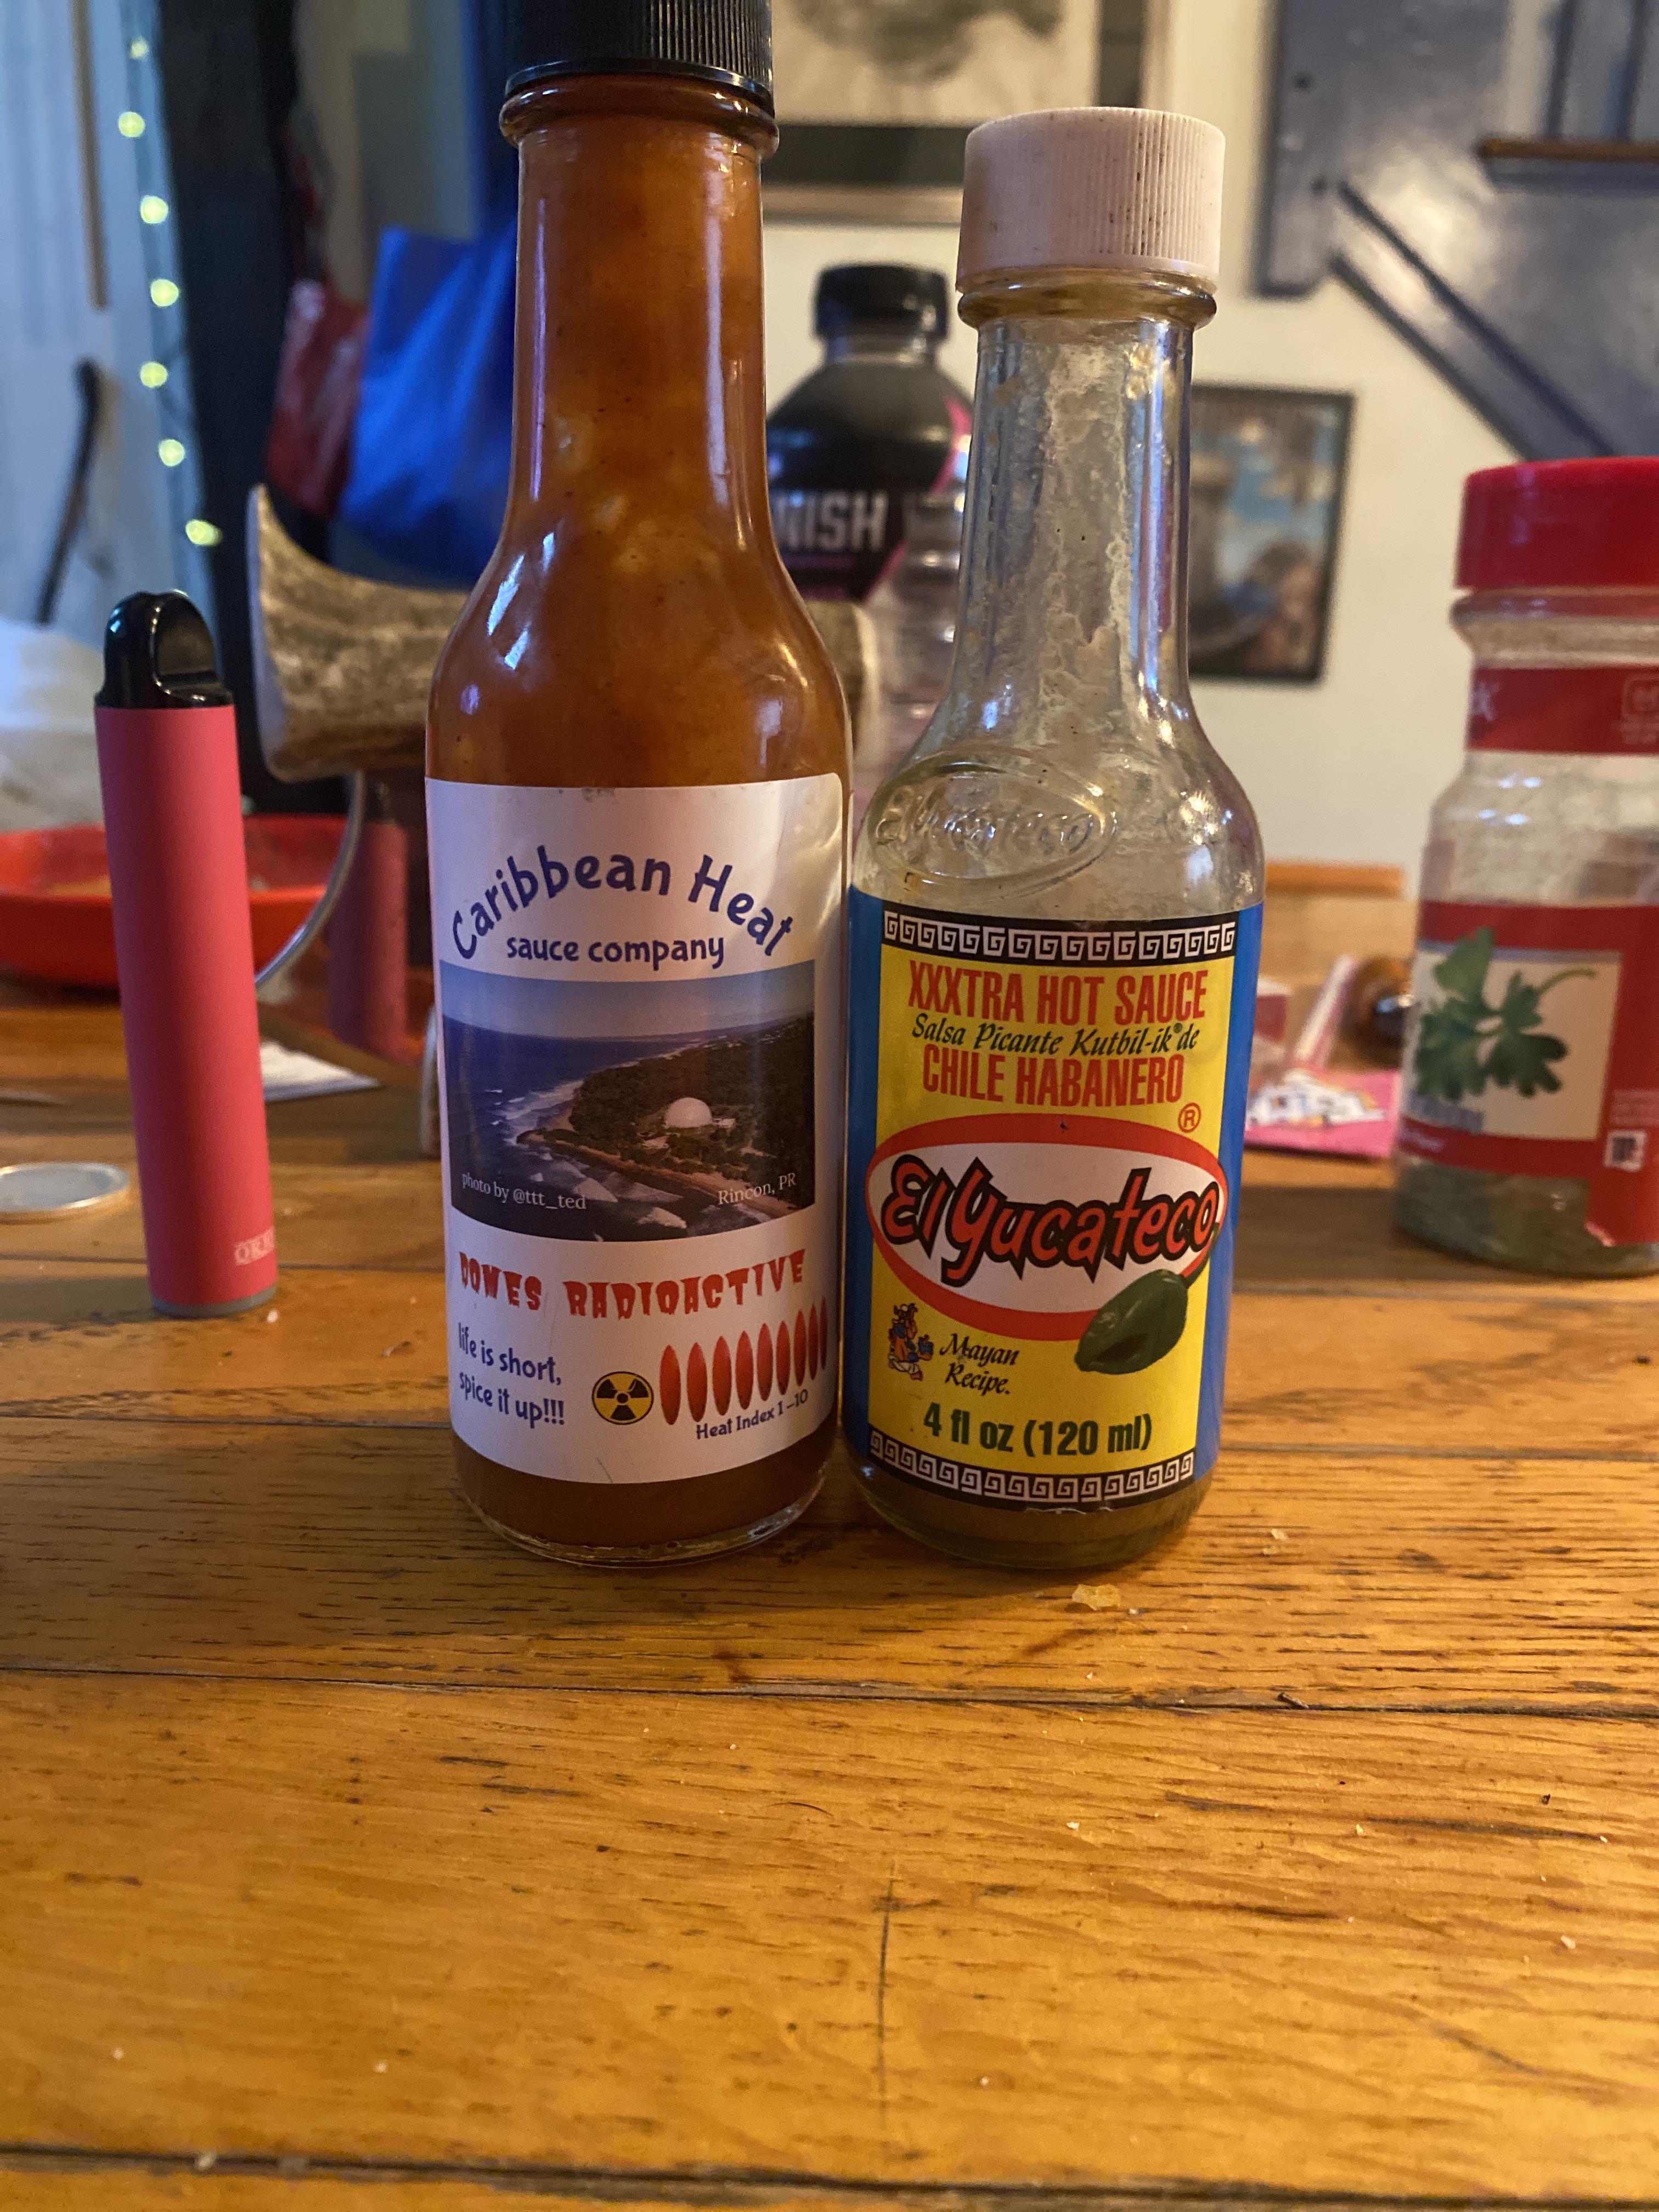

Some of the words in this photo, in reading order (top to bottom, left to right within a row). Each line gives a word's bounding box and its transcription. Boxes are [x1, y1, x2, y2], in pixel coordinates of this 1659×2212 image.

[453, 845, 670, 959] Caribbean
[688, 855, 793, 956] Heat
[507, 936, 578, 962] sauce
[589, 936, 725, 970] company
[909, 960, 1024, 1024] XXXTRA
[1037, 974, 1104, 1026] HOT
[1114, 970, 1209, 1025] SAUCE
[912, 1013, 966, 1046] Salsa
[976, 1023, 1063, 1055] Picante
[1177, 1023, 1200, 1051] de
[922, 1043, 1005, 1102] CHILE
[1015, 1053, 1184, 1107] HABANERO
[462, 1172, 490, 1194] photo
[494, 1181, 509, 1203] by
[514, 1188, 586, 1209] @ttt_ted
[718, 1181, 775, 1205] Rincon,
[778, 1172, 796, 1189] PR
[881, 1154, 956, 1258] El
[941, 1157, 1220, 1287] Yucateco
[562, 1249, 805, 1319] RADIOACTIVE
[459, 1323, 477, 1358] life
[481, 1340, 494, 1366] is
[500, 1347, 561, 1386] short,
[939, 1333, 1019, 1365] Mayan
[460, 1372, 493, 1407] spice
[498, 1389, 510, 1414] it
[515, 1398, 564, 1429] up!!!
[945, 1364, 1010, 1395] Recipe.
[696, 1418, 732, 1440] Heat
[736, 1408, 775, 1431] Index
[924, 1402, 941, 1437] 4
[951, 1408, 969, 1444] fl
[980, 1421, 1013, 1452] oz
[1024, 1419, 1098, 1457] (120
[1107, 1413, 1153, 1452] ml)
